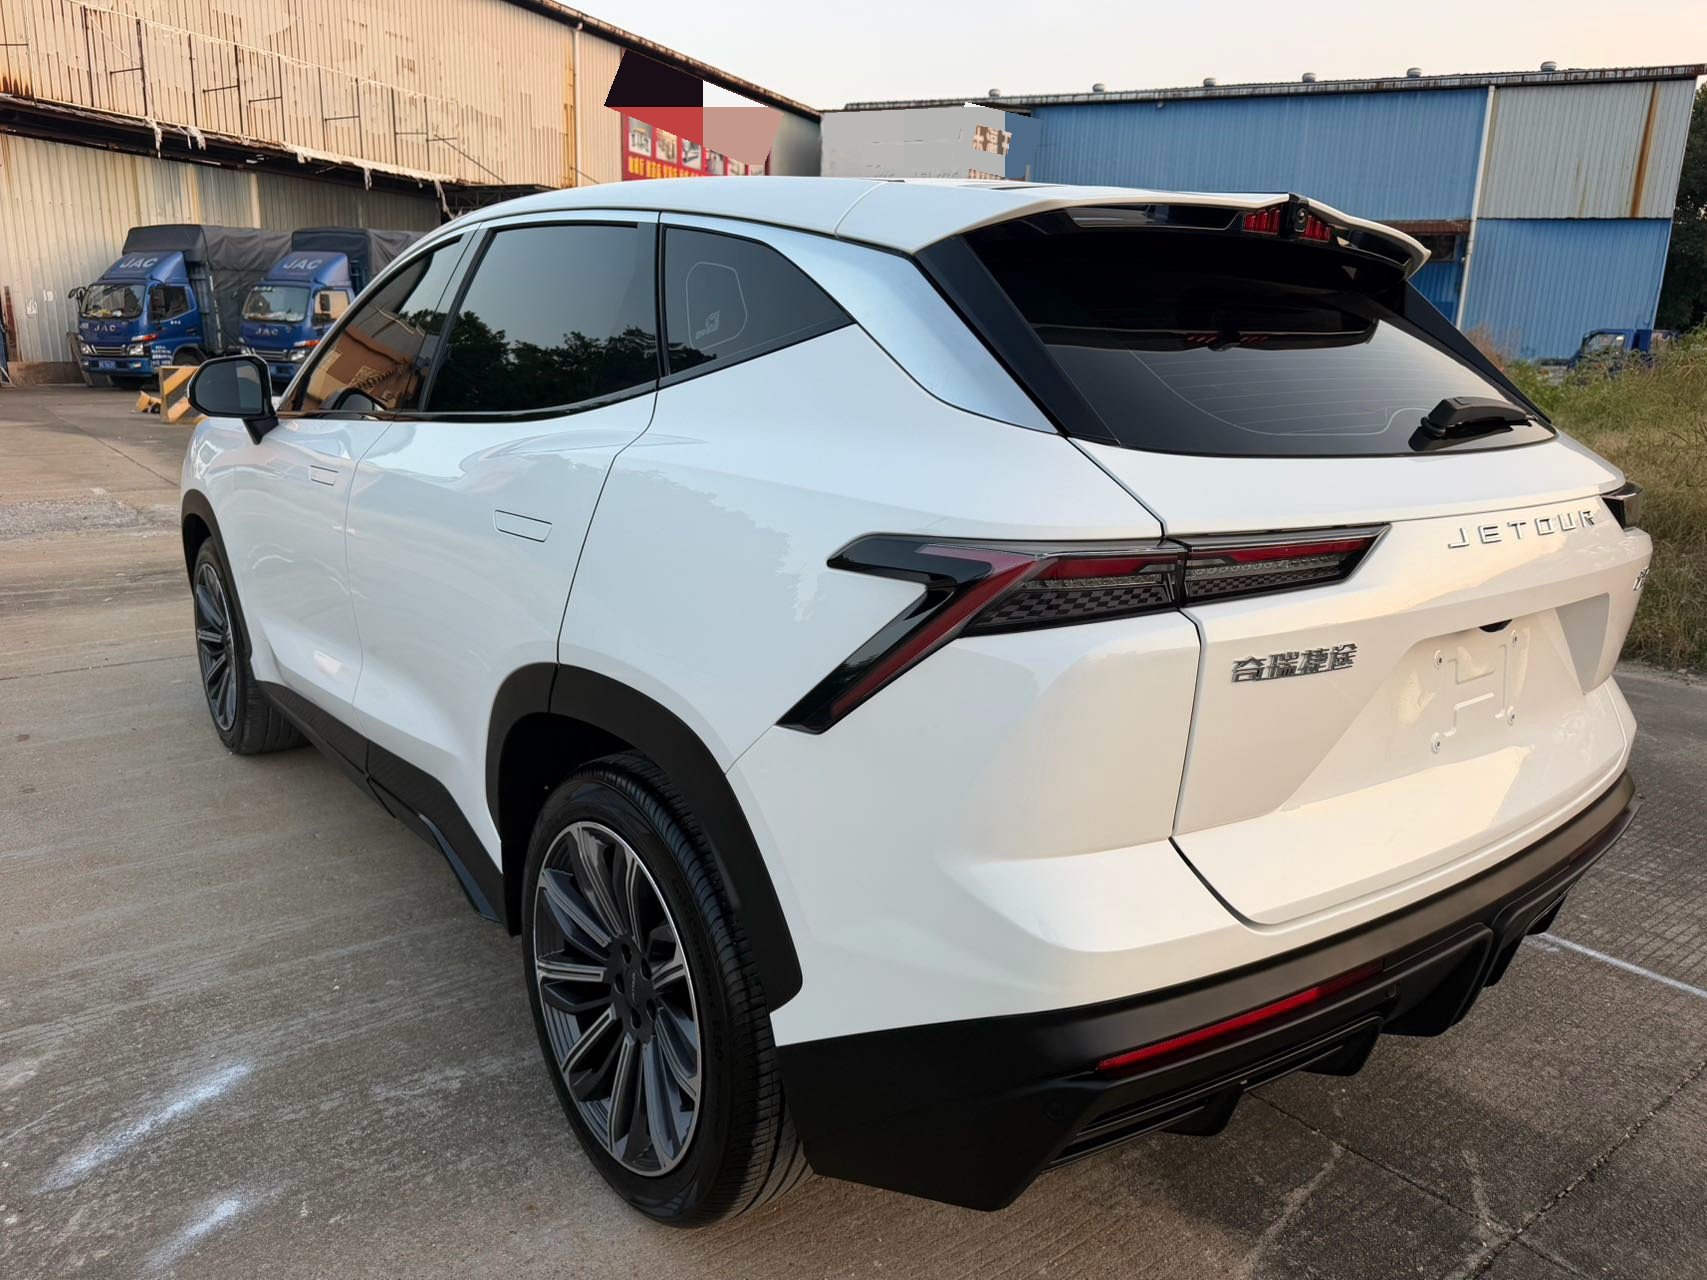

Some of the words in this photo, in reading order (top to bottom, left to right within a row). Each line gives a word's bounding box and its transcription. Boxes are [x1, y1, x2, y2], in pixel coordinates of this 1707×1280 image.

[119, 257, 159, 269] JAC
[282, 259, 323, 270] JAC
[93, 324, 117, 332] JAC
[255, 327, 279, 336] JAC
[1448, 510, 1597, 549] JETOUR
[1231, 642, 1358, 683] 奇瑞捷途
